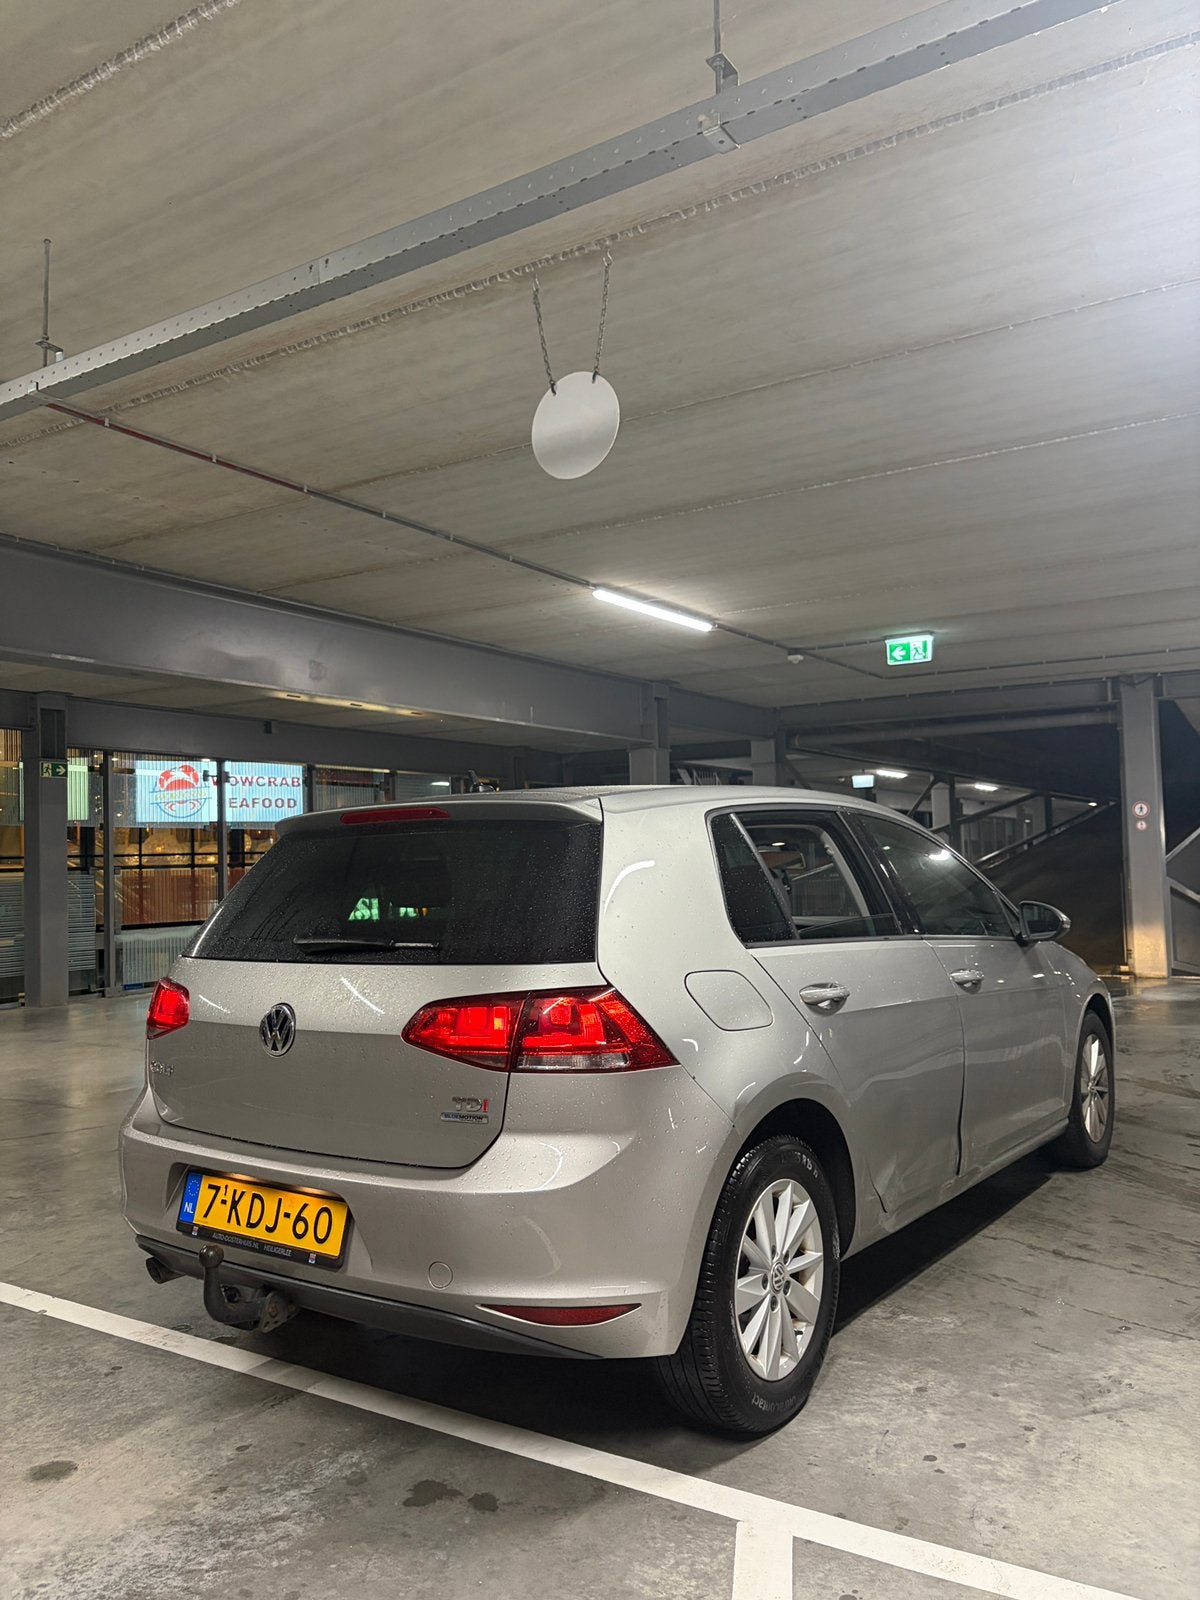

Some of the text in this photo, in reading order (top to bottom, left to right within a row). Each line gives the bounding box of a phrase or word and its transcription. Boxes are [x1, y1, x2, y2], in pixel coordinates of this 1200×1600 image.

[228, 797, 297, 808] EAFOOD
[183, 1201, 194, 1214] NL
[203, 1184, 333, 1244] 7-KDJ-60
